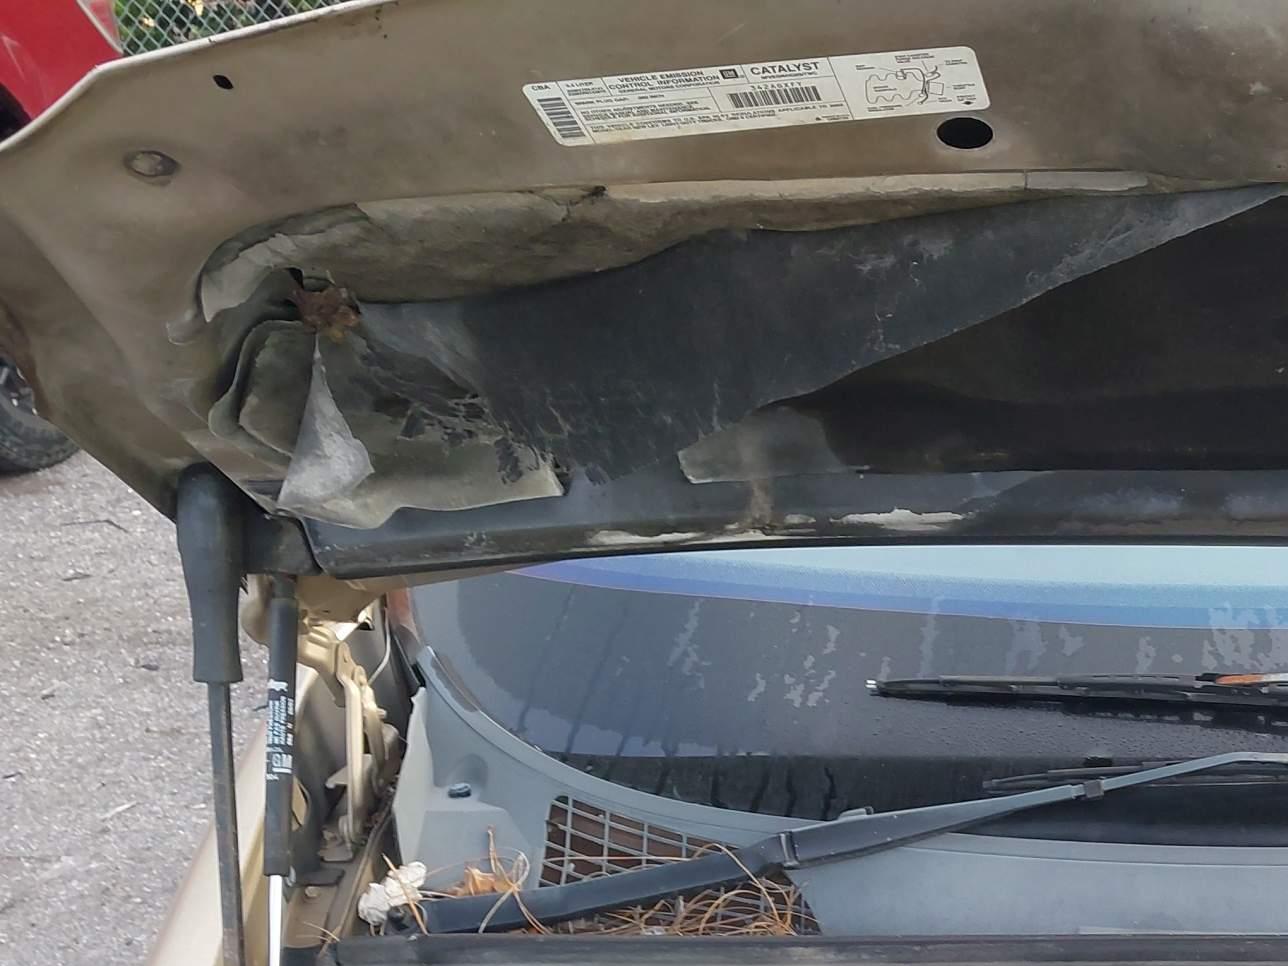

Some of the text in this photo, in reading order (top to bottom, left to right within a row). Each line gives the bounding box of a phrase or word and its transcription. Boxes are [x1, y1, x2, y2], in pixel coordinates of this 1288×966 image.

[750, 62, 820, 76] CATALYST
[608, 80, 654, 91] CONTROL
[660, 74, 720, 86] INFORMATION
[617, 70, 705, 84] VEHICLE EMISSION
